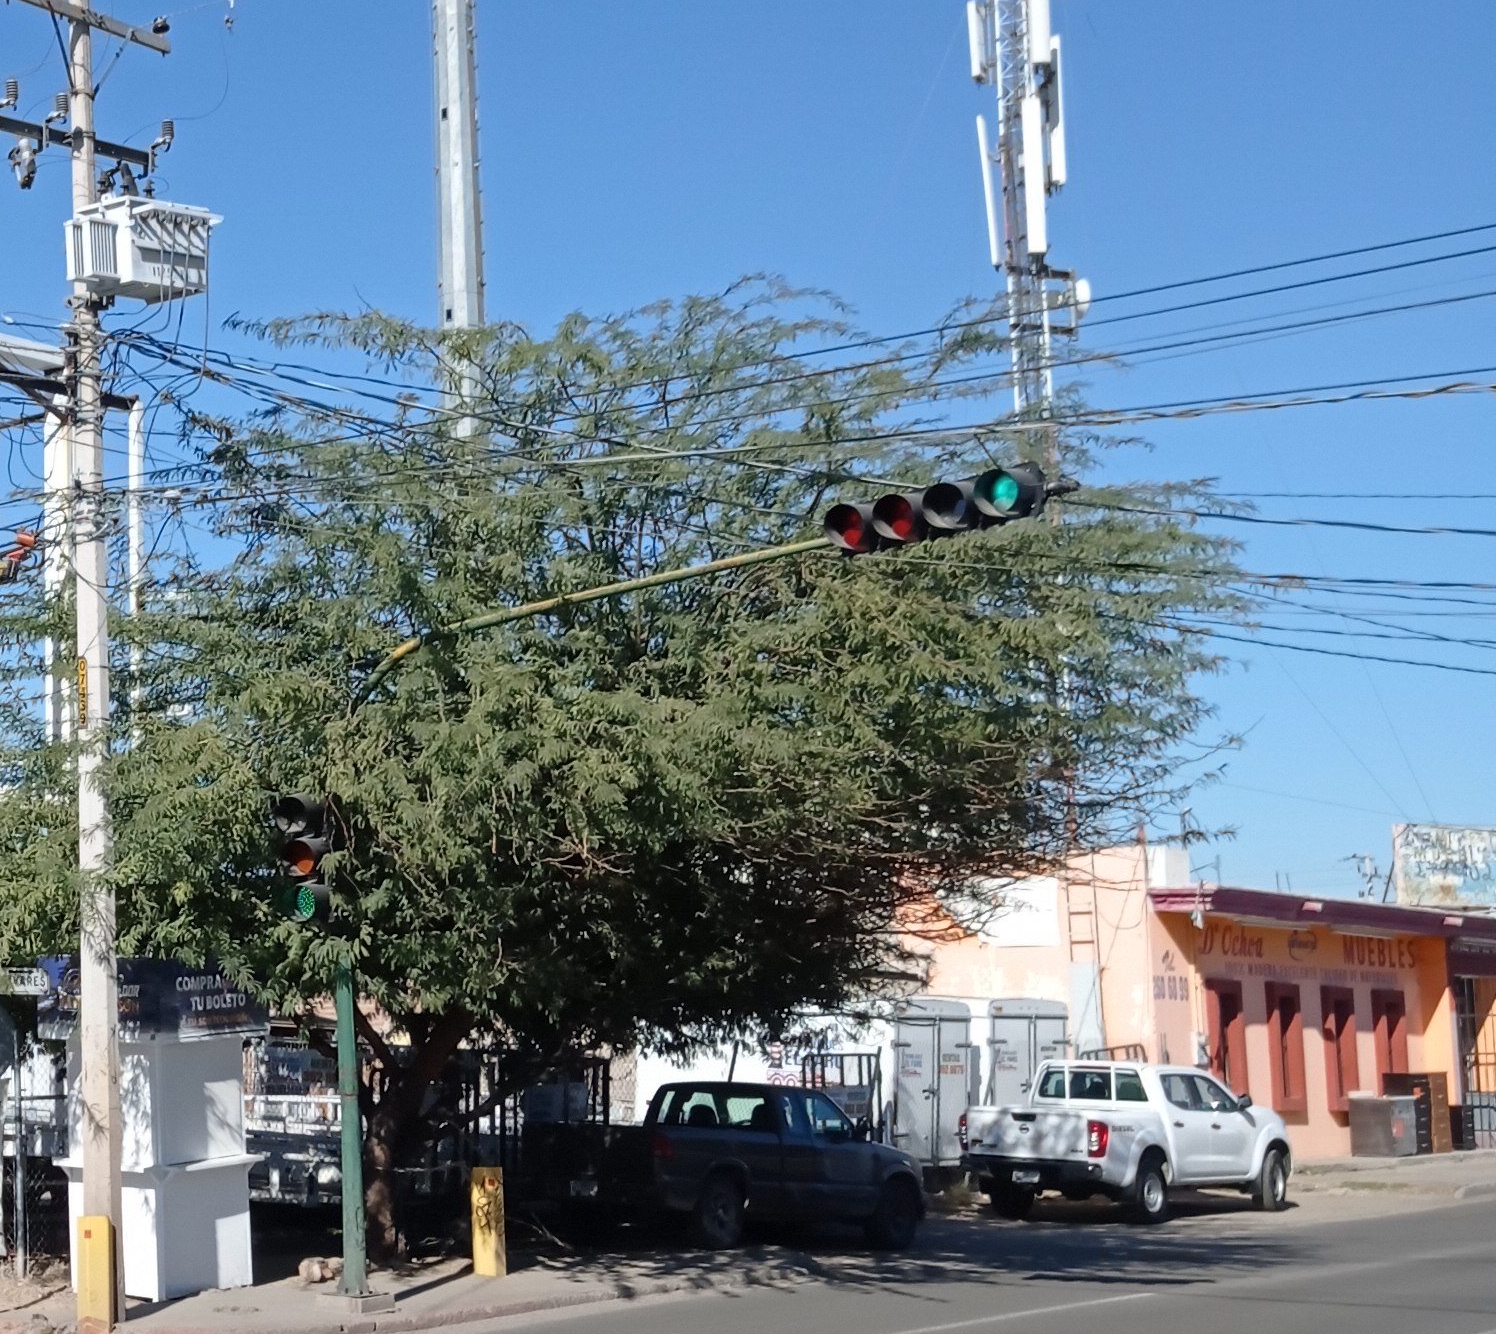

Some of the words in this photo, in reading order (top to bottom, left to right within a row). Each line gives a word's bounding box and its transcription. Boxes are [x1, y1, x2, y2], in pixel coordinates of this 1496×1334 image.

[1343, 934, 1416, 969] MUEBLES
[175, 974, 222, 991] COMPRA
[190, 996, 204, 1011] TU
[206, 993, 246, 1010] BOLETO
